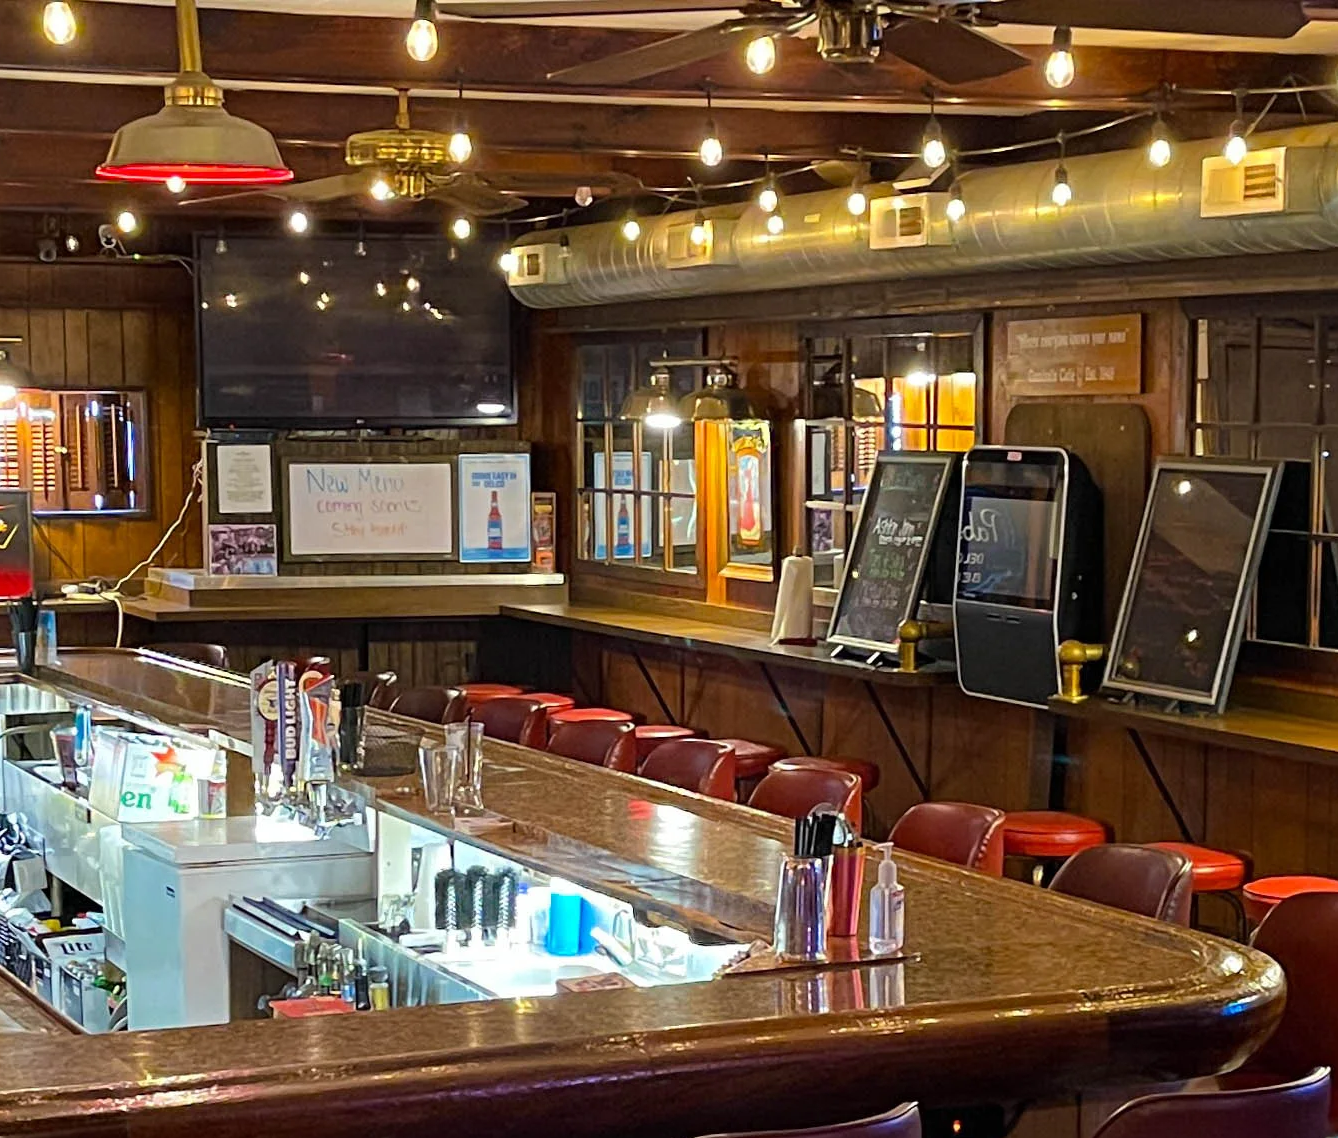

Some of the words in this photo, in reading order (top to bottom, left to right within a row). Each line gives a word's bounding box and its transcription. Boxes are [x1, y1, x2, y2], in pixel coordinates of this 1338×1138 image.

[284, 678, 297, 725] LIGHT
[285, 725, 297, 760] BUD
[61, 941, 93, 955] Lite
